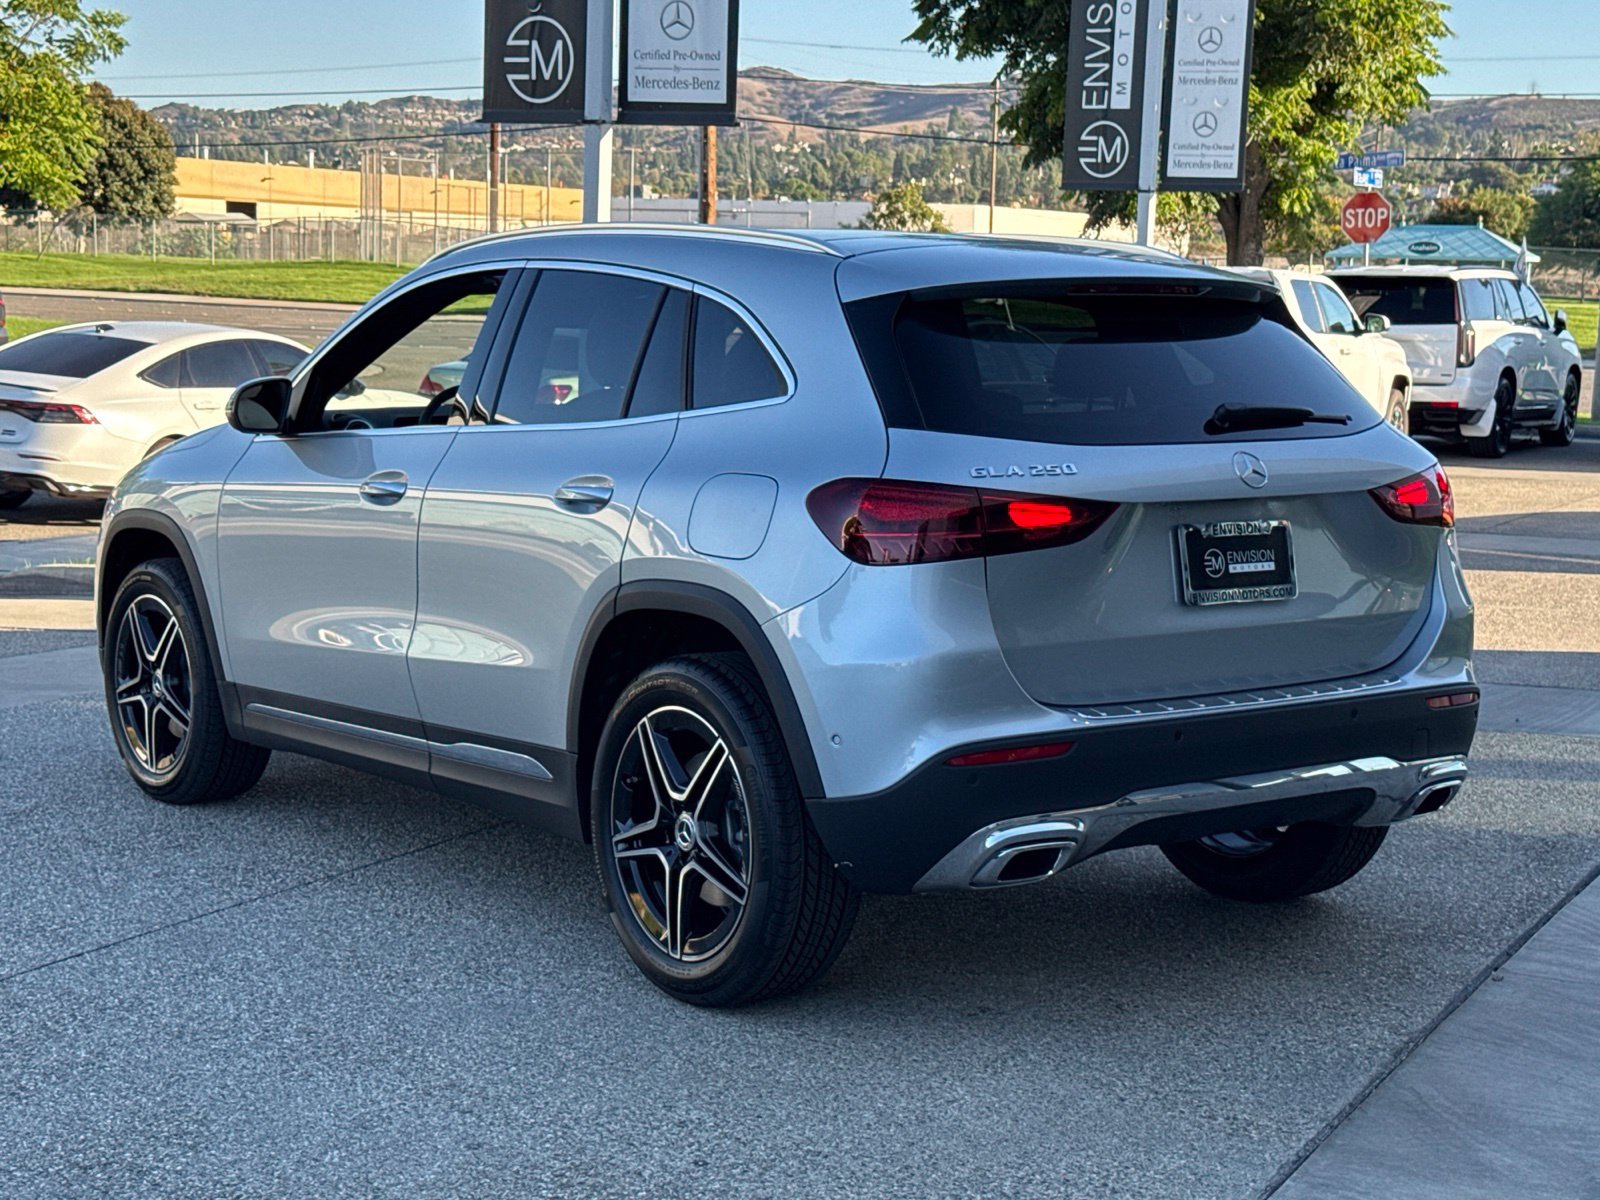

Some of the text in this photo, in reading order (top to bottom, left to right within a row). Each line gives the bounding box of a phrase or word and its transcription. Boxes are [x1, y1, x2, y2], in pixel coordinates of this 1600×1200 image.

[633, 49, 721, 62] Certified Pre-Owned
[1178, 58, 1240, 67] Certified Pre-Owned
[634, 75, 721, 91] Mercedes-Benz
[1177, 76, 1239, 86] Mercedes-Benz
[1173, 142, 1235, 151] Certified Pre-Owned
[1172, 159, 1233, 170] Mercedes-Benz
[1345, 207, 1389, 229] STOP
[970, 463, 1079, 478] GLA 250
[1212, 522, 1262, 535] ENVISION
[1226, 549, 1275, 563] ENVISION
[1192, 587, 1293, 602] ENVISIONMOTORS.COM
